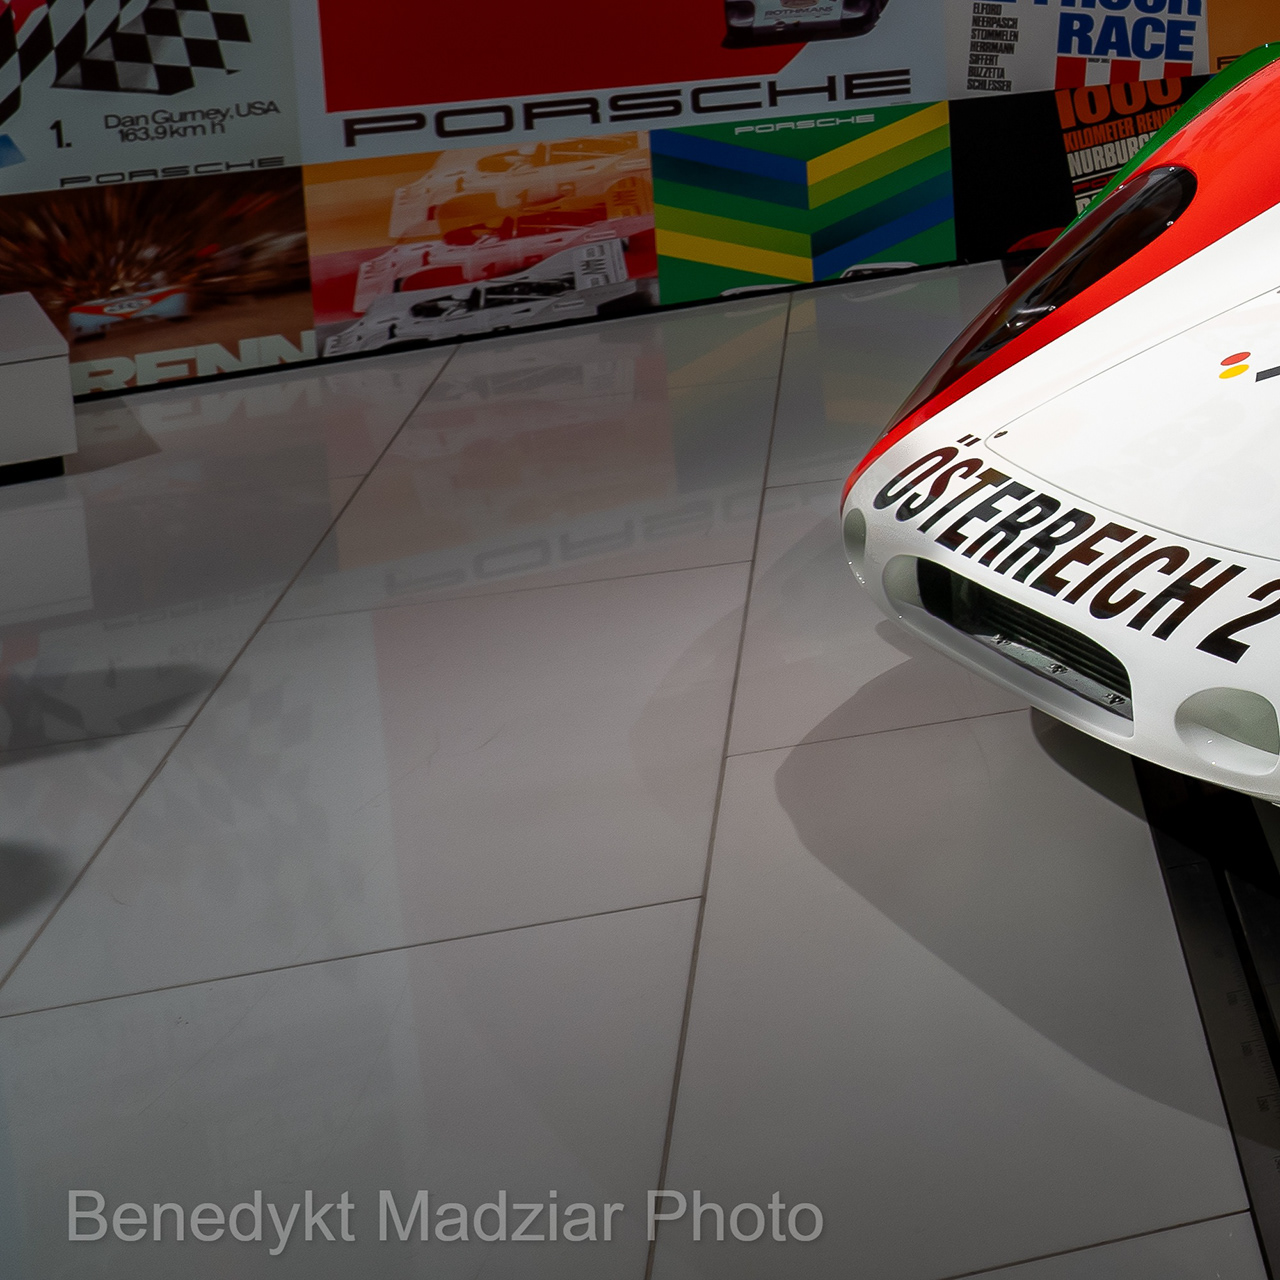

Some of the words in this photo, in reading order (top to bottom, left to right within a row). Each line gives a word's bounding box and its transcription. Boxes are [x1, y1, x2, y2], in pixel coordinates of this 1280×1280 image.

[973, 3, 1002, 15] ELFORD
[972, 16, 1018, 30] NEERPASCH
[971, 28, 1018, 42] STOMMELEN
[1057, 12, 1196, 61] RACE
[970, 41, 1015, 55] HERRMANN
[969, 53, 999, 67] SIFFERT
[968, 67, 1005, 80] BUZZETTA
[967, 79, 1012, 92] SCHLESSER
[104, 114, 149, 130] Dan
[235, 101, 281, 117] USA
[344, 69, 911, 147] PORSCHE
[50, 120, 72, 148] 1.
[734, 114, 875, 135] PORSCHE
[1063, 117, 1135, 153] KILOMETER
[60, 156, 284, 187] PORSCHE
[872, 434, 1246, 640] ÖSTERREICH
